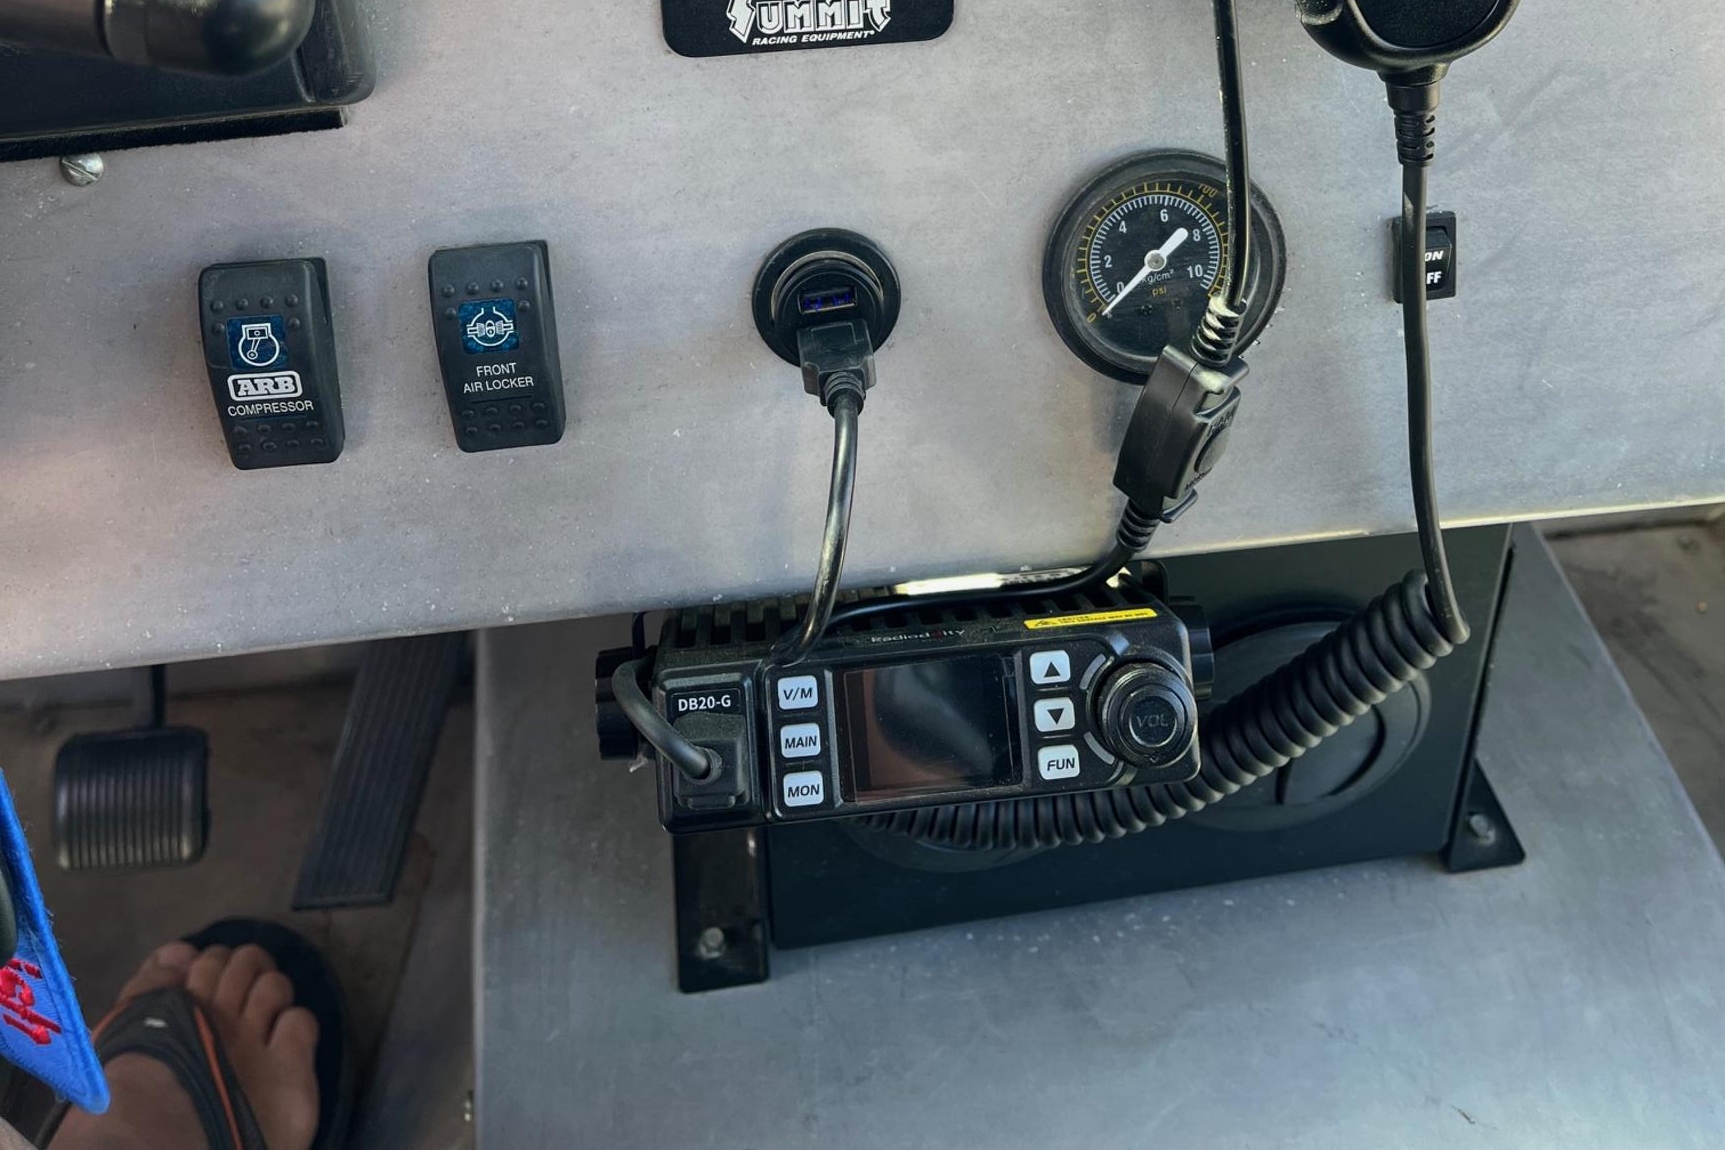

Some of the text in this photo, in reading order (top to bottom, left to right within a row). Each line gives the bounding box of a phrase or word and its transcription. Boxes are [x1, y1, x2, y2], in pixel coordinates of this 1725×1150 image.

[752, 34, 797, 46] RACING
[1160, 208, 1169, 223] 6
[1118, 220, 1128, 234] 4
[1192, 229, 1201, 242] 8
[1103, 254, 1113, 268] 2
[1424, 250, 1444, 262] ON
[1186, 264, 1203, 279] 10
[1426, 271, 1442, 285] FF
[1152, 286, 1168, 299] psi
[476, 362, 517, 377] FRONT
[236, 375, 298, 397] ARB
[463, 376, 535, 394] AIR LOCKER
[227, 399, 315, 418] COMPRESSOR
[783, 687, 813, 701] V/M
[678, 694, 732, 712] DB20-G
[1136, 713, 1169, 728] VOL
[784, 735, 817, 750] MAIN
[1047, 757, 1075, 772] FUN
[788, 783, 820, 798] MON
